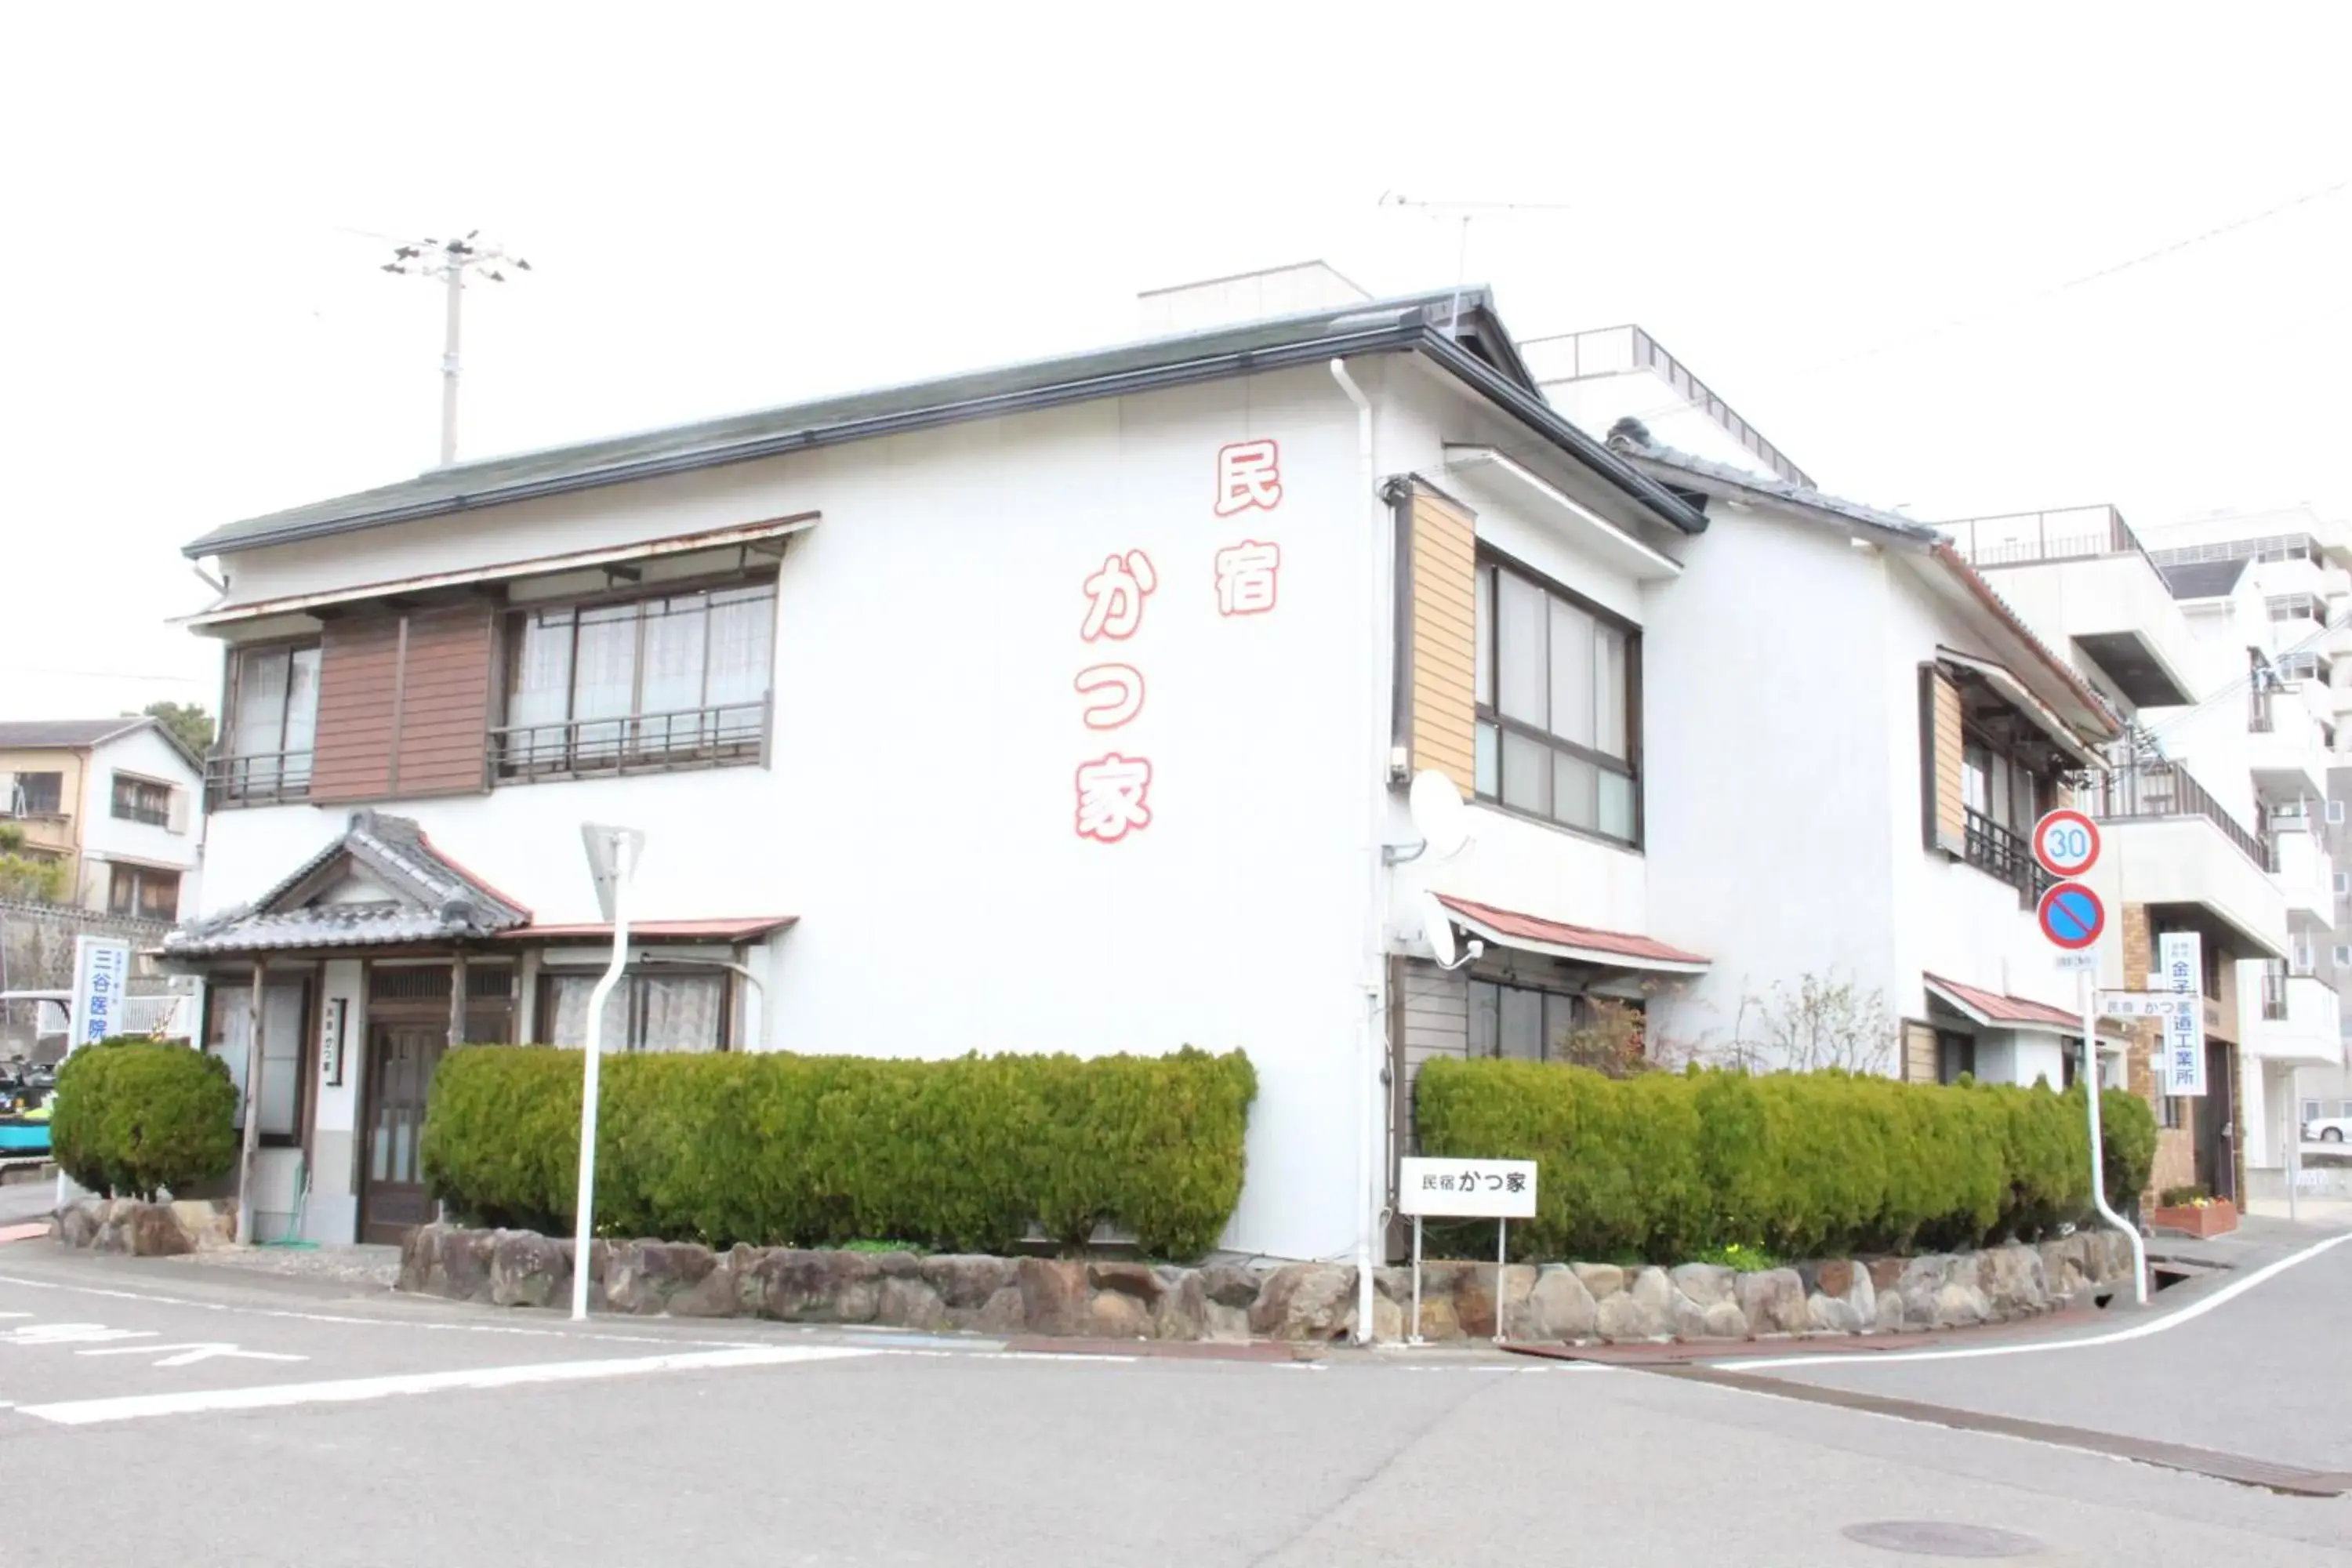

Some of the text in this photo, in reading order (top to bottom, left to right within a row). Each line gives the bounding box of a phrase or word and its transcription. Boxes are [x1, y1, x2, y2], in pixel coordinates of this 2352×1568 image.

[1214, 439, 1283, 617] 民宿
[1074, 549, 1158, 844] かつ家
[2049, 829, 2086, 858] 30
[87, 949, 112, 1040] 三谷医院
[2171, 960, 2194, 1086] 金子道工業所
[1421, 1170, 1526, 1193] 民宿かつ家
